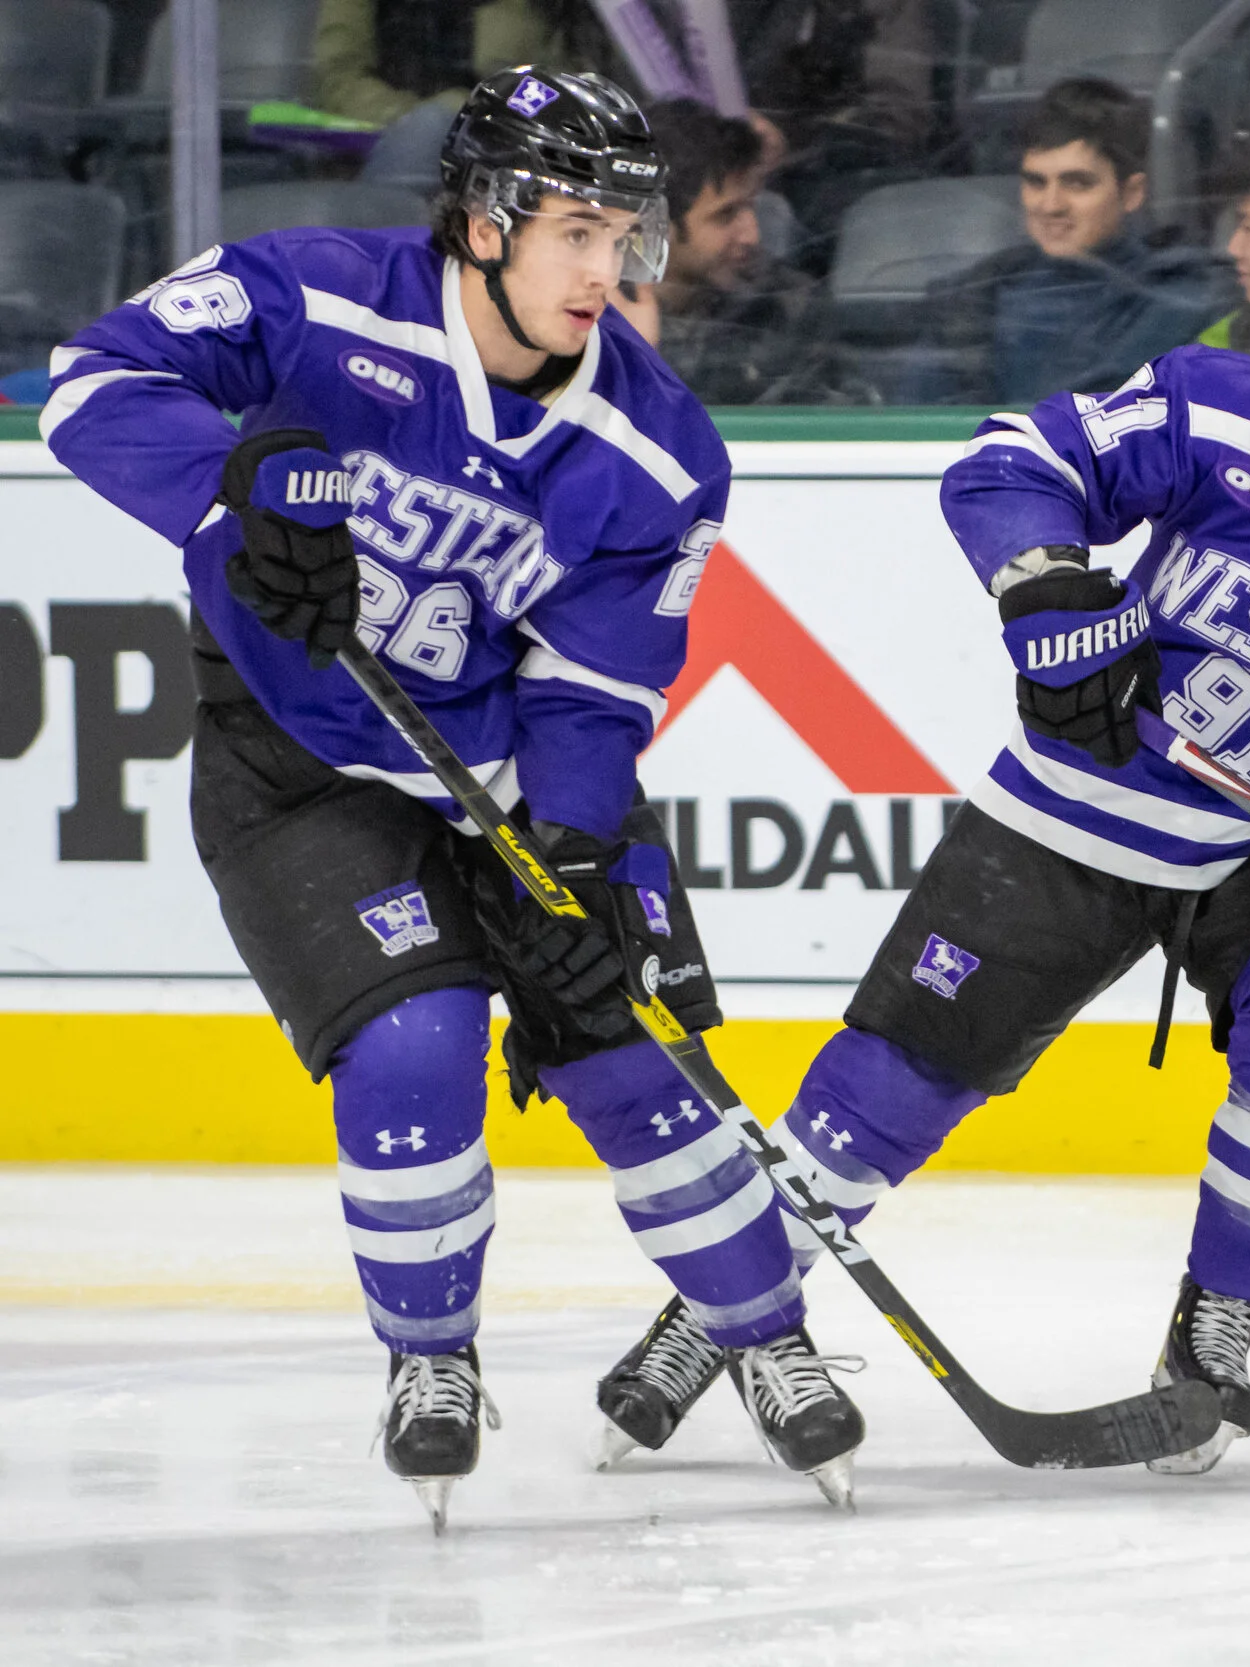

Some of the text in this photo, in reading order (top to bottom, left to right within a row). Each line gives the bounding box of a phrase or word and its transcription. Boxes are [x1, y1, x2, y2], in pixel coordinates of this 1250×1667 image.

[611, 159, 659, 177] CCM
[347, 355, 415, 402] OUA
[341, 450, 564, 620] ESTER
[355, 554, 471, 681] 26
[496, 824, 558, 893] SUPER
[647, 796, 965, 890] LDAL
[722, 1104, 872, 1264] CCM
